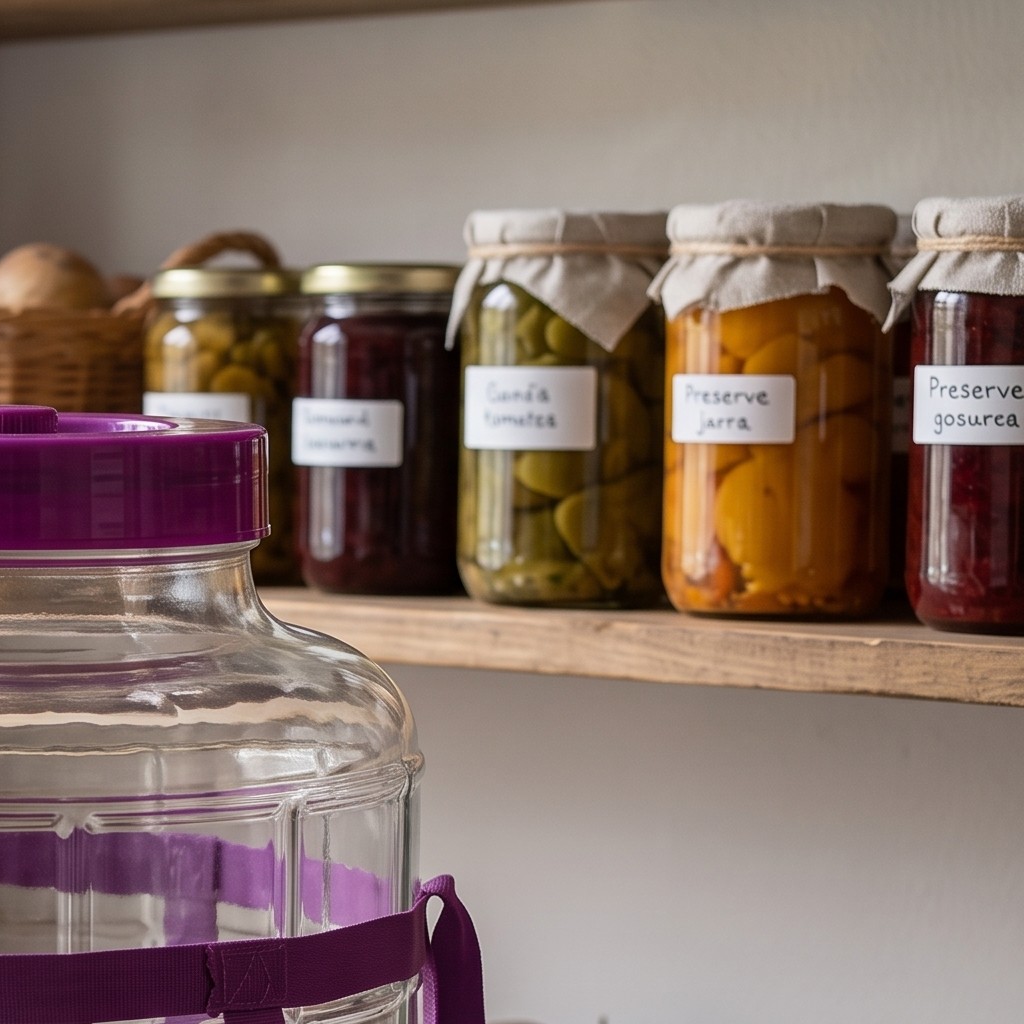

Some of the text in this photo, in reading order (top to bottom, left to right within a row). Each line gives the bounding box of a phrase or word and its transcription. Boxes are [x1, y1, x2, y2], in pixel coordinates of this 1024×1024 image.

[685, 384, 769, 406] Preserve
[928, 375, 1024, 399] Preserve
[934, 413, 1020, 435] gosurea
